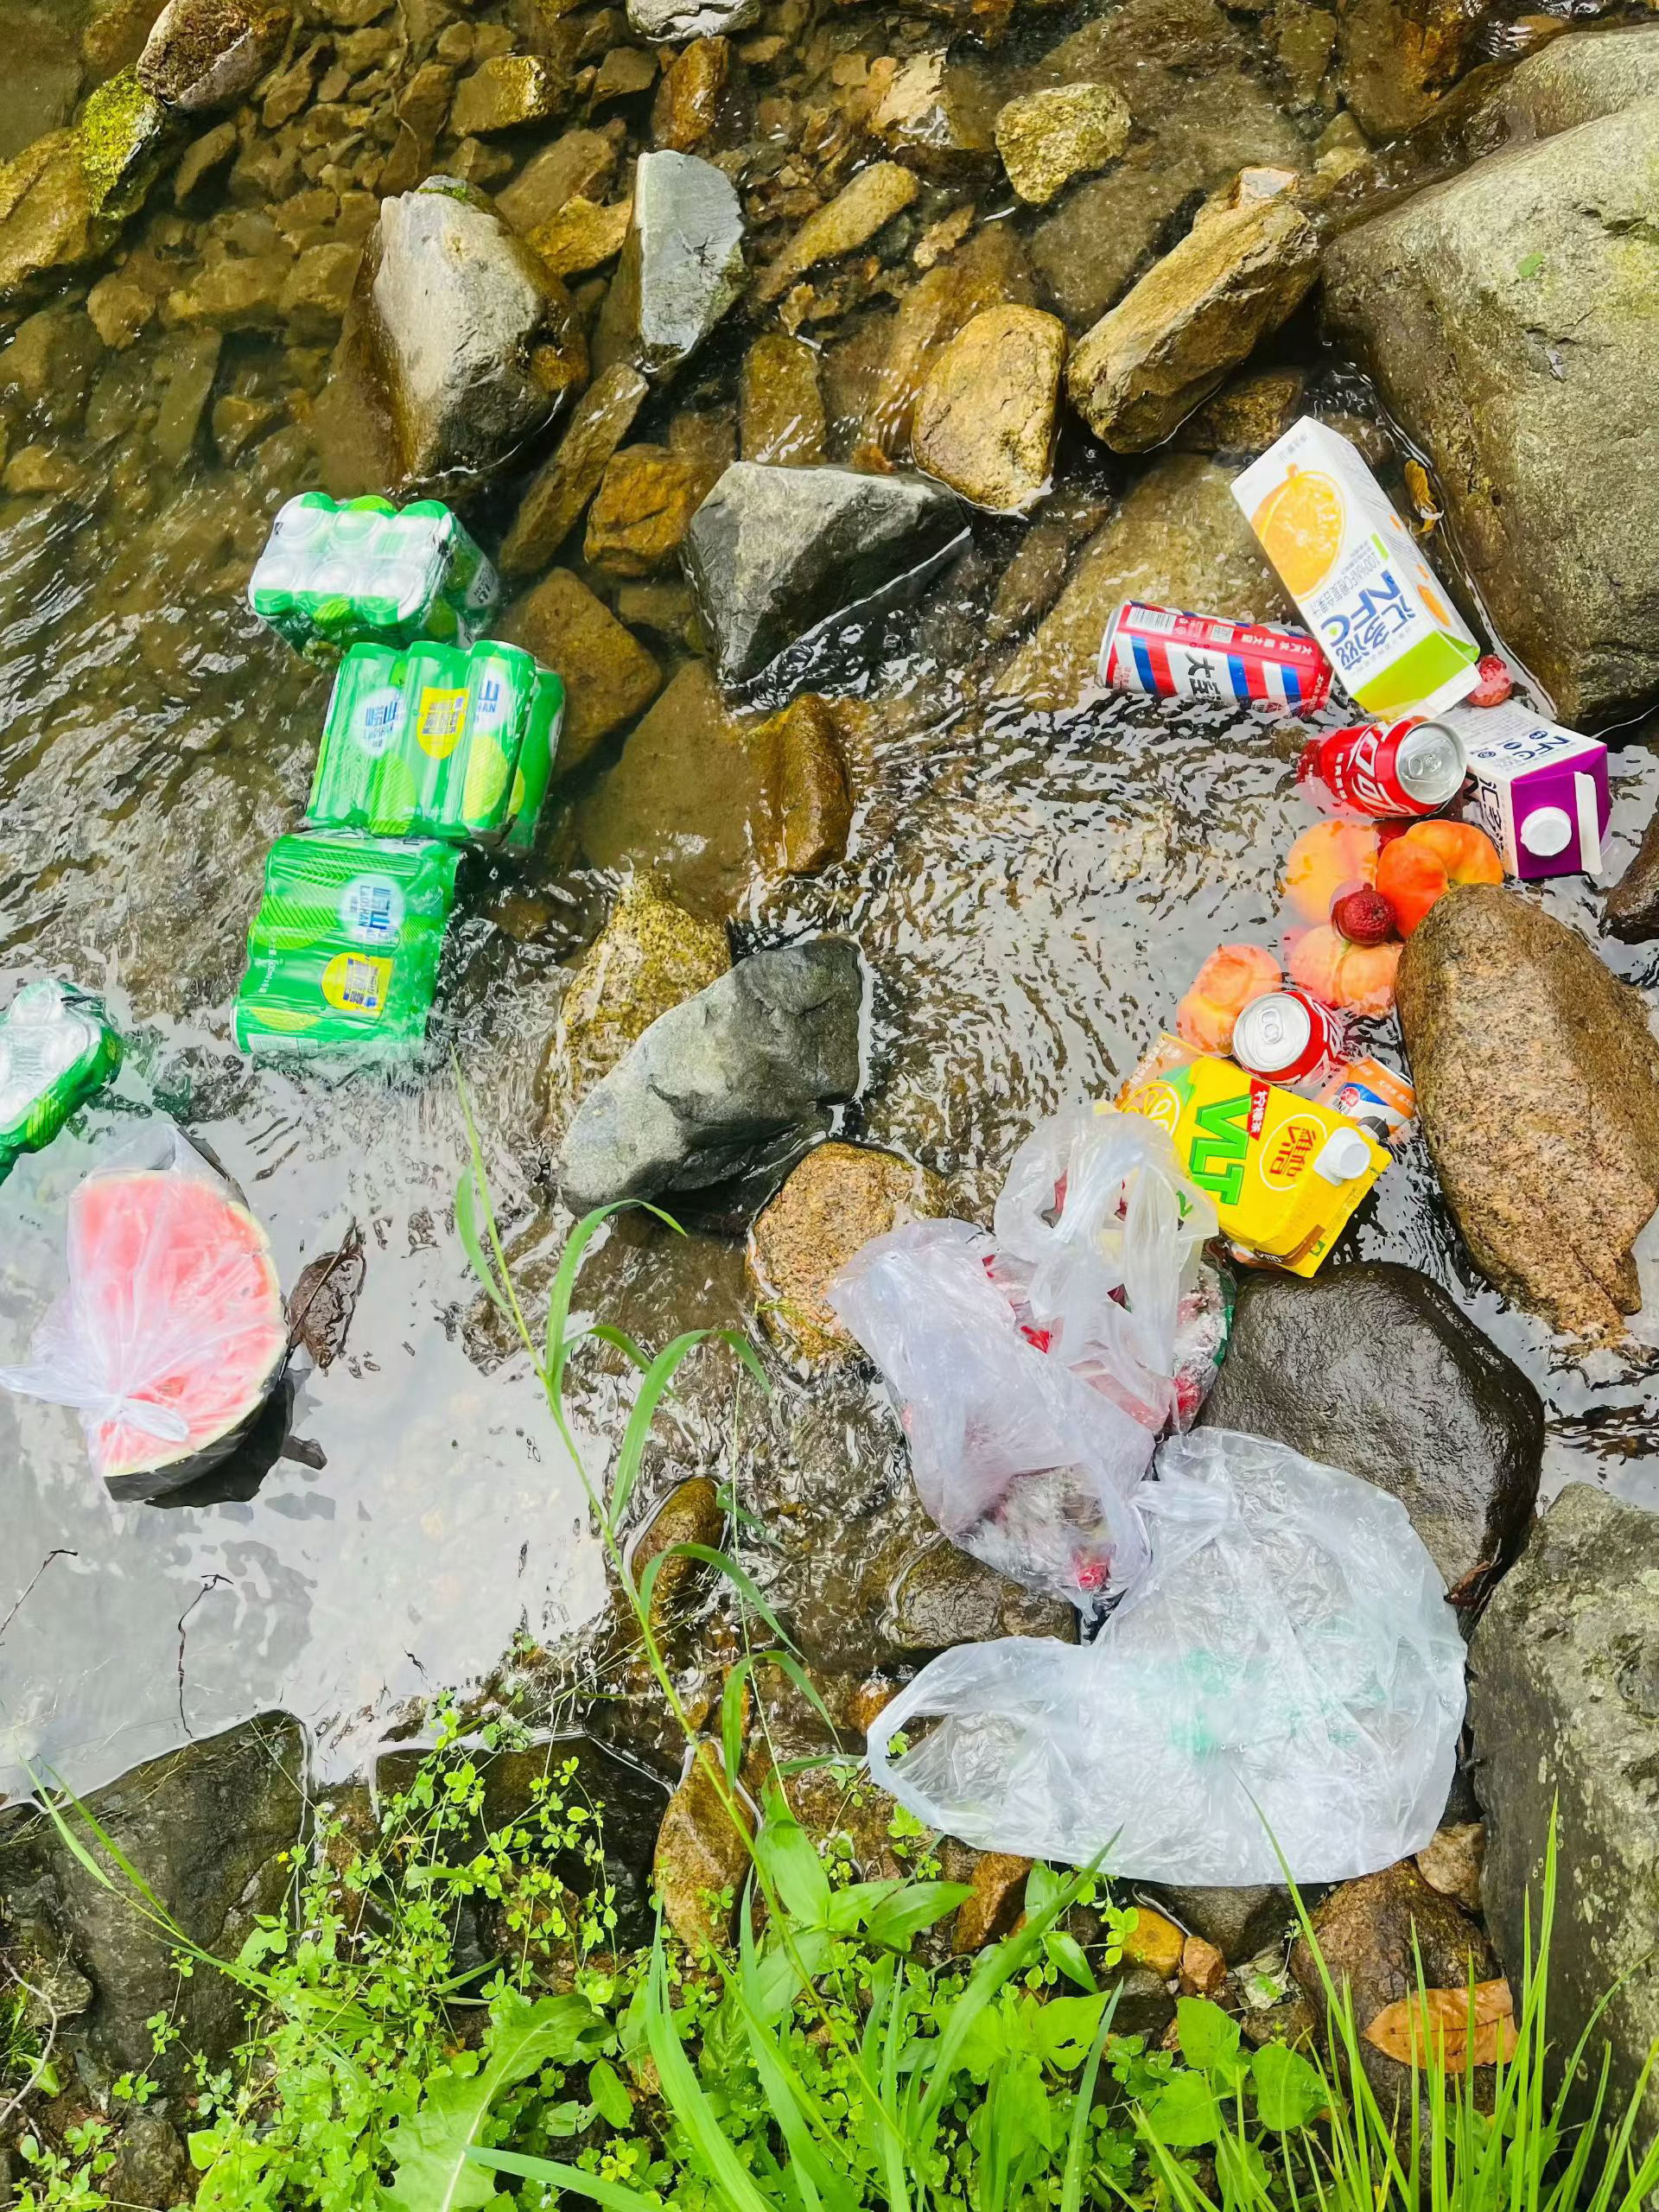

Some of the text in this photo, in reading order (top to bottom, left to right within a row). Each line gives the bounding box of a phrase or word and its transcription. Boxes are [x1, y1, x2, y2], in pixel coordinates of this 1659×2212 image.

[1320, 569, 1402, 647] NFC
[1336, 594, 1416, 671] 汇多滋
[1512, 735, 1572, 760] NFC
